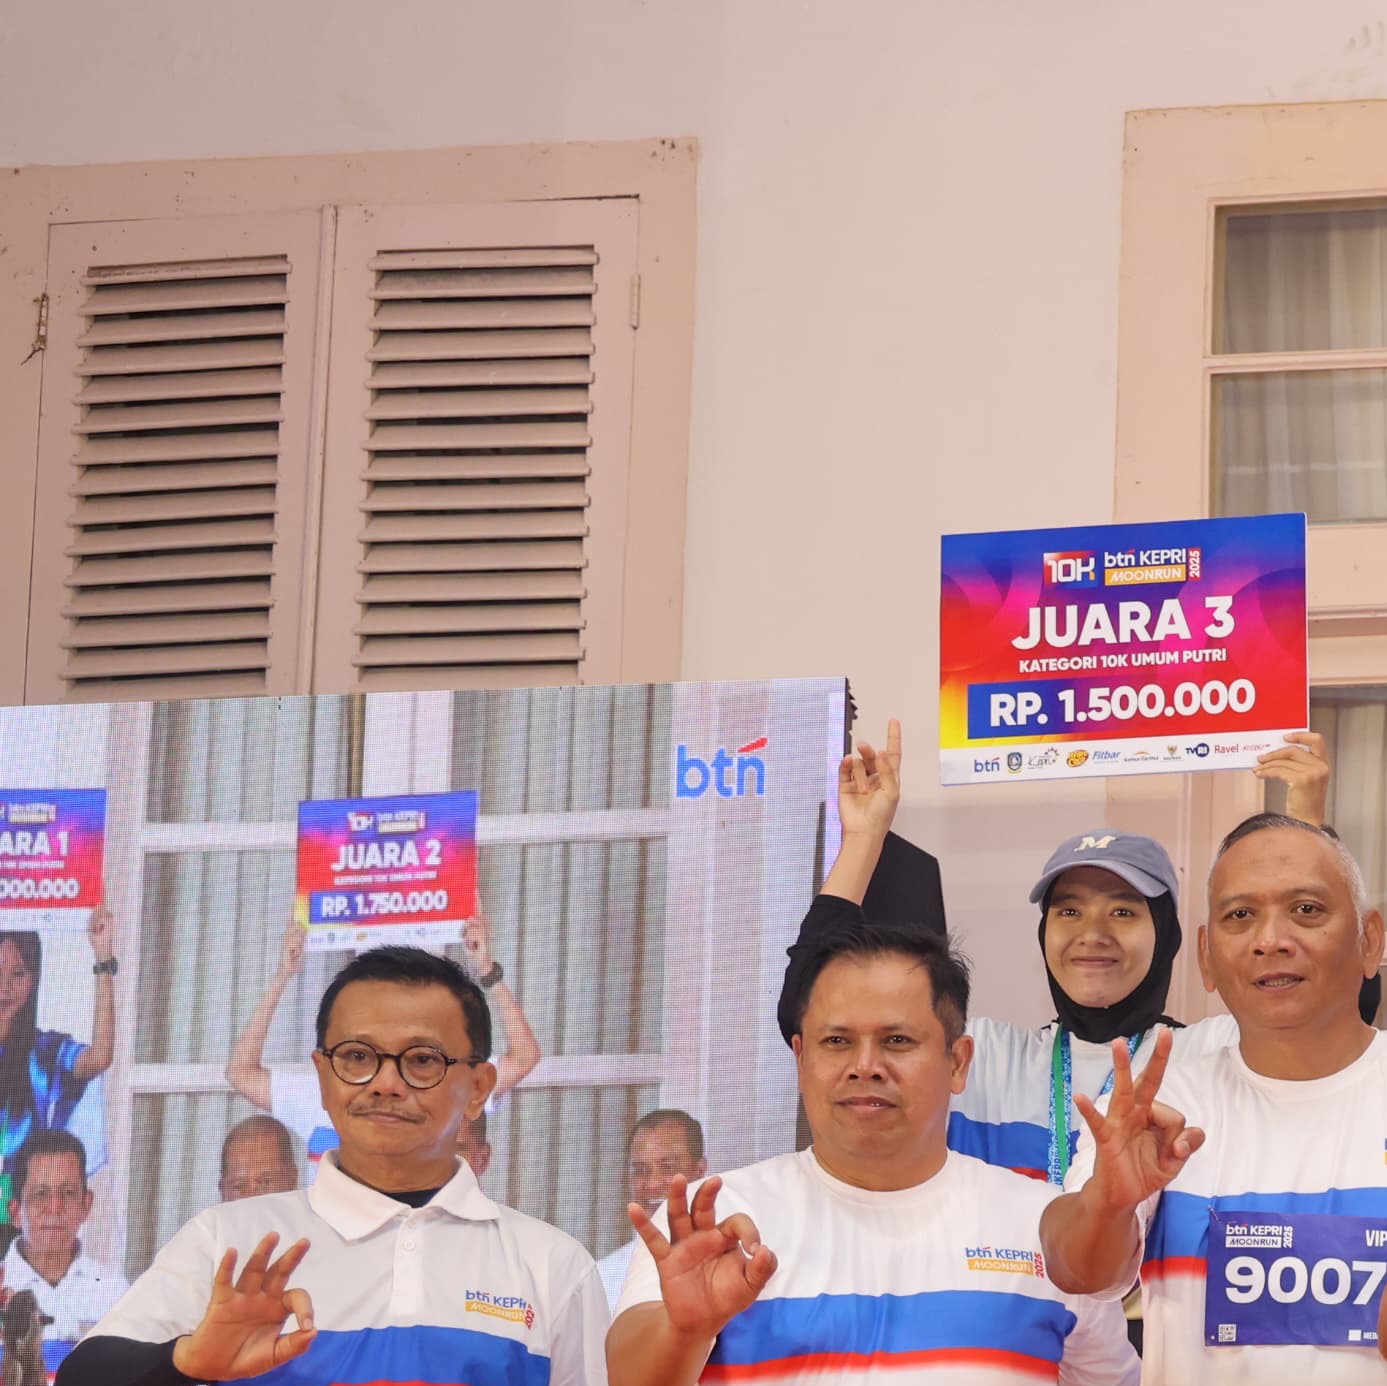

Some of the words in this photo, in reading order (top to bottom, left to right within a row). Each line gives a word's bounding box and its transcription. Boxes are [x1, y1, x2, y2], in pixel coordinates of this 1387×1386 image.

[1104, 550, 1135, 568] btn
[1140, 549, 1185, 566] KEPRI
[1189, 551, 1200, 577] 2025
[1110, 568, 1182, 583] MOONRUN
[1012, 599, 1191, 649] JUARA
[1204, 596, 1234, 638] 3
[1019, 658, 1097, 672] KATEGORI
[1101, 655, 1127, 668] 10K
[1132, 651, 1179, 666] UMUM
[1184, 649, 1226, 662] PUTRI
[990, 692, 1048, 727] RP.
[1058, 679, 1255, 722] 1.500.000
[676, 737, 768, 798] btn
[974, 757, 1000, 772] btn
[1093, 750, 1121, 760] Fitbar
[1215, 744, 1238, 754] Ravel
[58, 832, 69, 856] 1
[331, 841, 420, 871] JUARA
[426, 840, 442, 865] 2
[321, 896, 350, 917] RP.
[356, 890, 448, 915] 1.750.000
[1226, 1223, 1248, 1235] btn
[1250, 1225, 1282, 1235] KEPRI
[1230, 1238, 1278, 1246] MOONRUN
[1284, 1226, 1293, 1248] 2025
[966, 1247, 992, 1258] btn
[995, 1248, 1033, 1261] KEPRI
[1034, 1252, 1044, 1278] 2025
[1225, 1256, 1387, 1305] 9007
